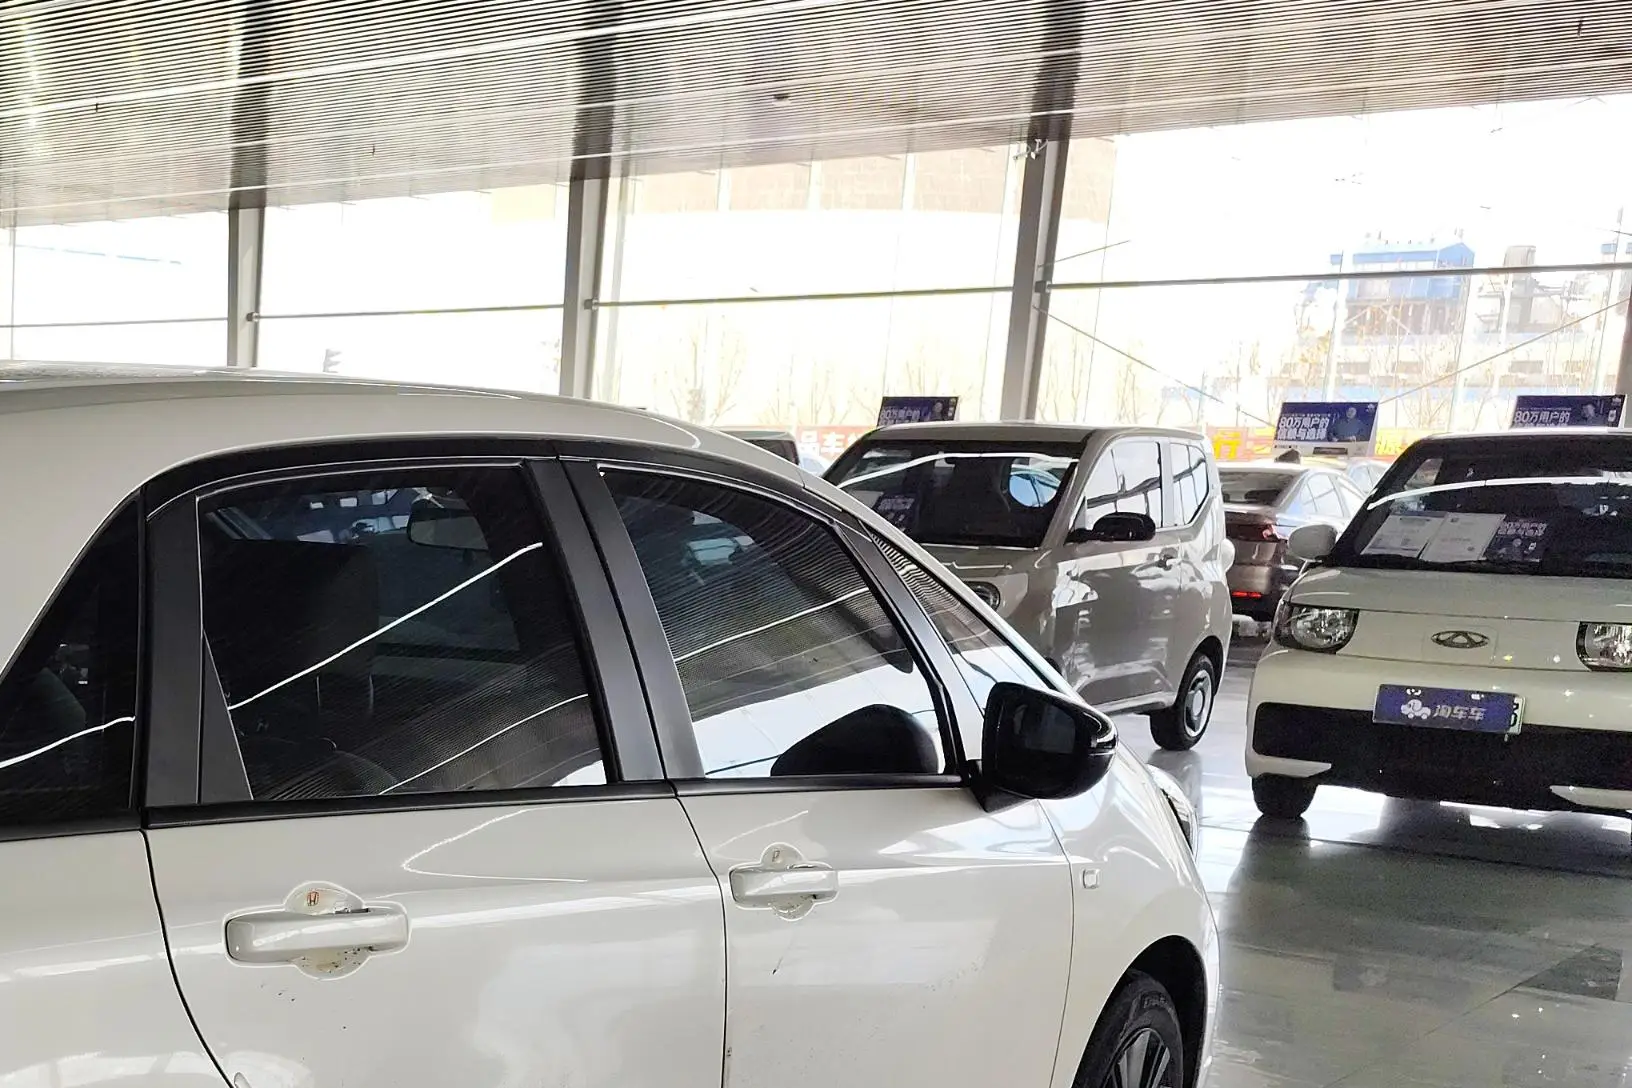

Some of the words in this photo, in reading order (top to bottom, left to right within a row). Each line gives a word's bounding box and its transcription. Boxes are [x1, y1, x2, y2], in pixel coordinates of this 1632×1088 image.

[1279, 416, 1330, 428] 80万用户的
[1514, 410, 1571, 423] 80万用户的
